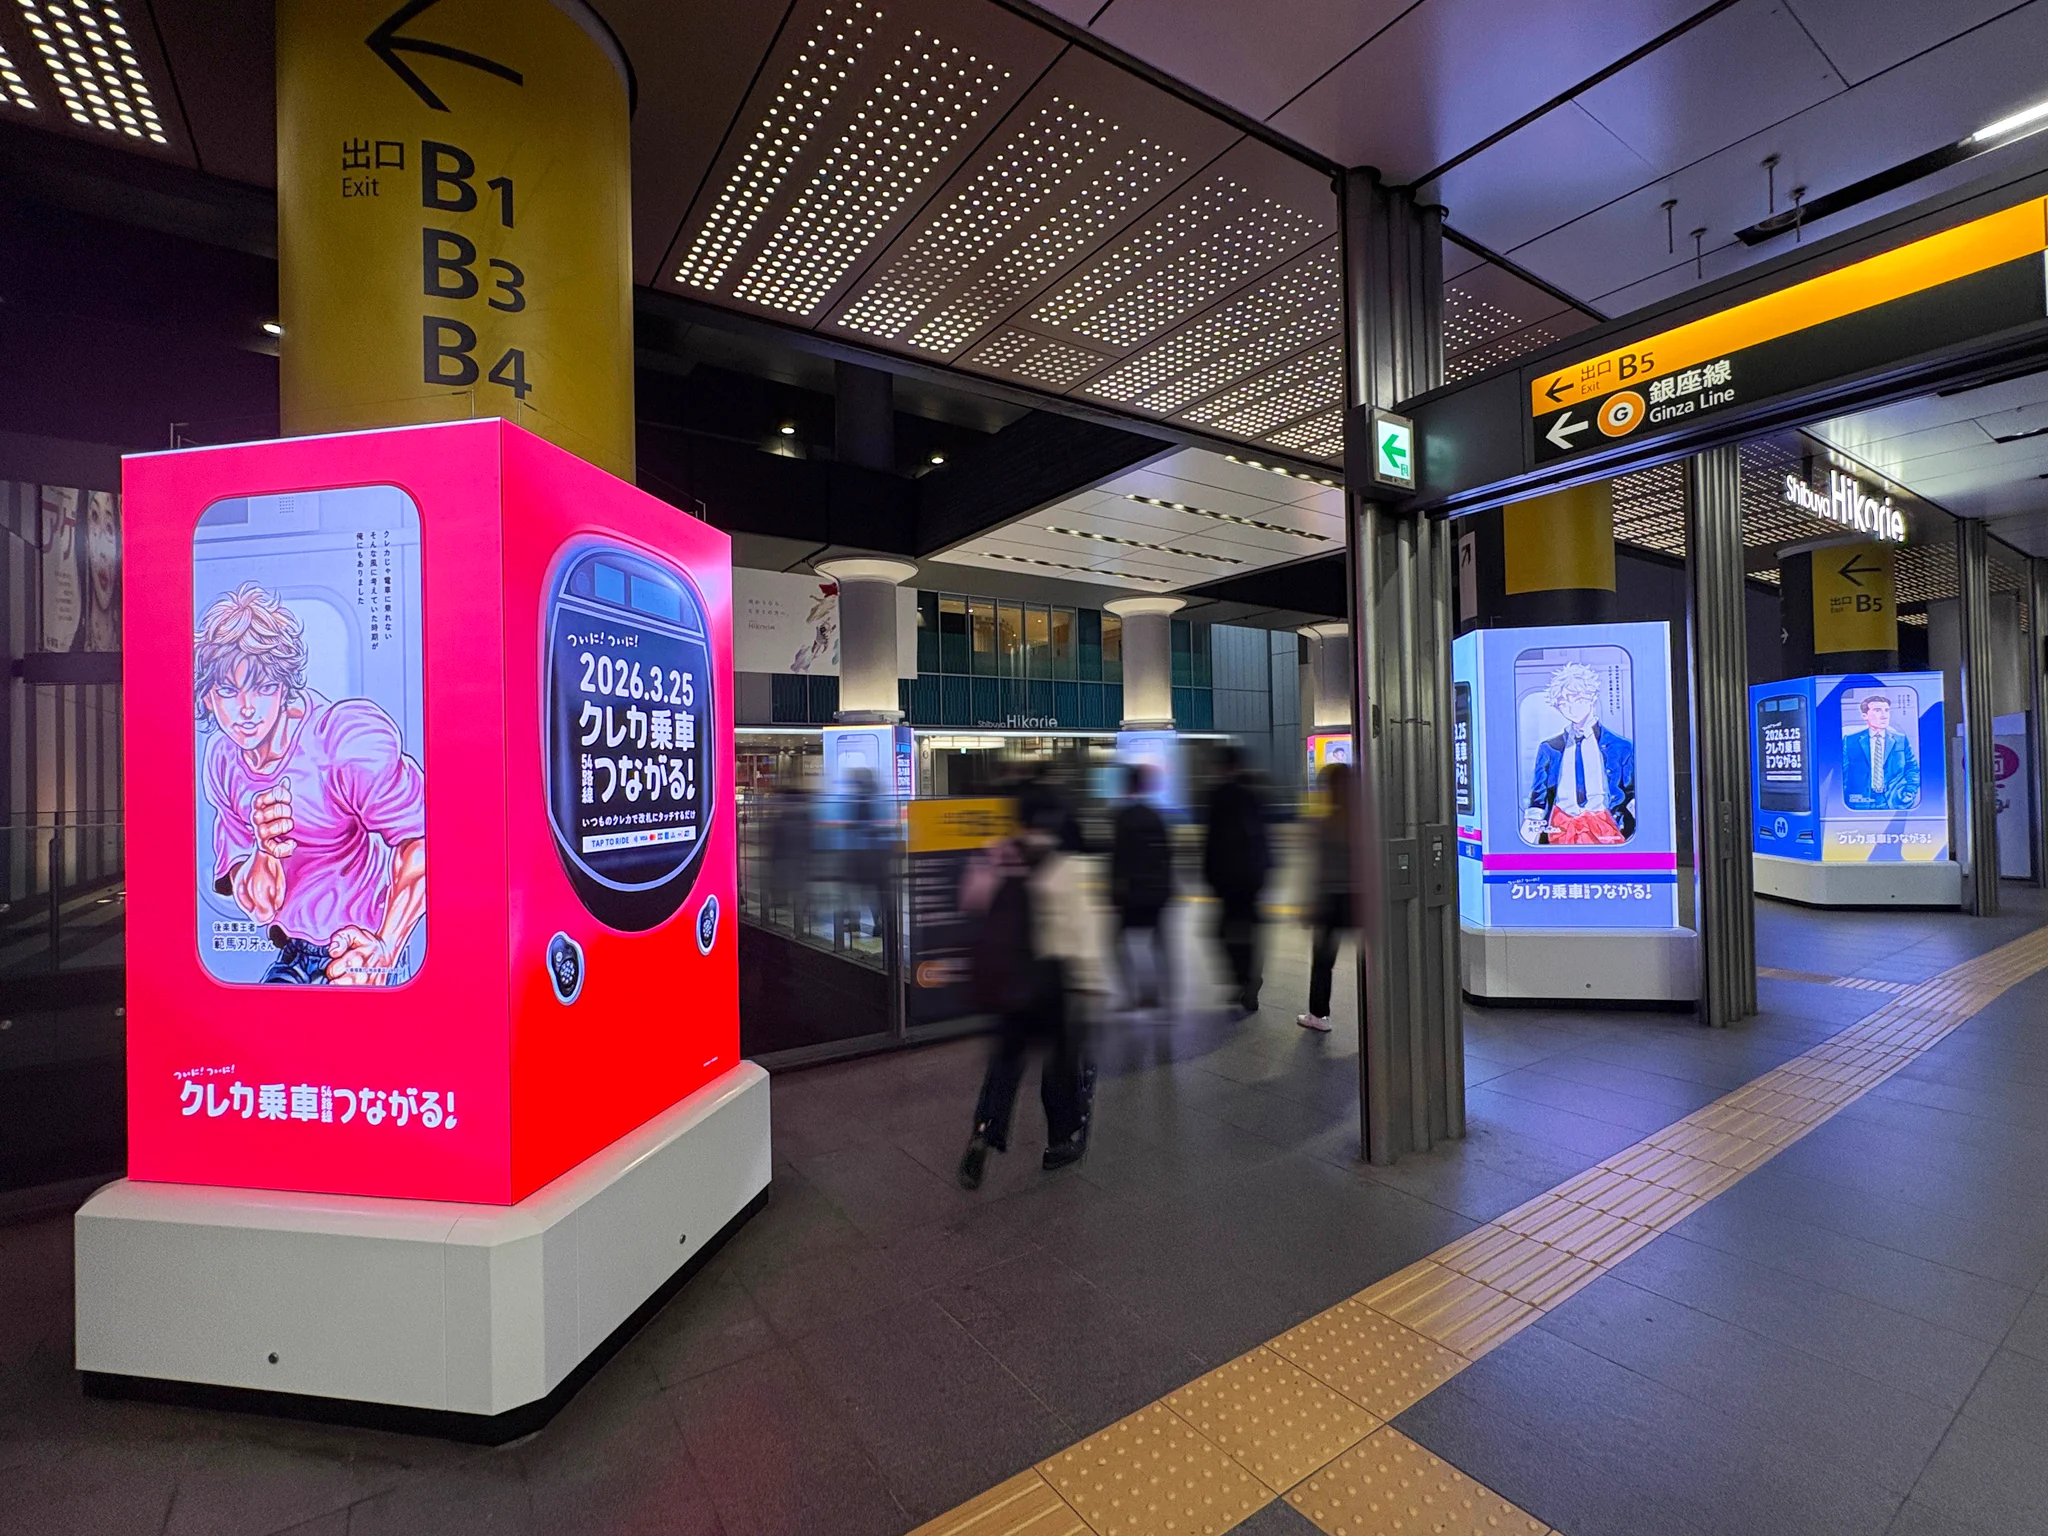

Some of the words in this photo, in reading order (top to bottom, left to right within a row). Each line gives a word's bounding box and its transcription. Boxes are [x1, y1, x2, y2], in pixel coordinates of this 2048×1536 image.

[342, 138, 404, 170] 出口
[421, 140, 516, 229] B1
[342, 176, 380, 198] Exit
[422, 227, 527, 314] B3
[422, 315, 533, 400] B4
[1581, 359, 1612, 383] 出口
[1618, 351, 1655, 381] B5
[1581, 381, 1600, 395] Exit
[1649, 359, 1732, 405] 銀座線
[1613, 406, 1629, 421] G
[1649, 399, 1695, 424] Ginza
[1700, 388, 1735, 410] Line
[1786, 474, 1831, 519] Shibuya
[1830, 469, 1905, 543] Hikarie
[356, 532, 364, 605] 俺にもありました
[383, 530, 392, 639] クレカじゃ電車に乗れない
[370, 531, 379, 650] そんな風に考えていた時期が
[1830, 596, 1852, 606] 出口
[1856, 594, 1883, 613] B5
[579, 652, 695, 707] 2026.3.25
[578, 700, 696, 751] クレカ乗車
[977, 720, 1006, 729] Shibuya
[1006, 714, 1058, 729] Hikarie
[1765, 728, 1801, 741] 2026.3.25
[582, 810, 696, 828] いつものクレカで改札にタッチするだけ
[591, 839, 604, 848] TAP
[605, 838, 615, 846] TO
[615, 837, 630, 845] RIDE
[214, 922, 256, 932] 後楽園王者
[214, 936, 275, 951] 範馬刃牙さん
